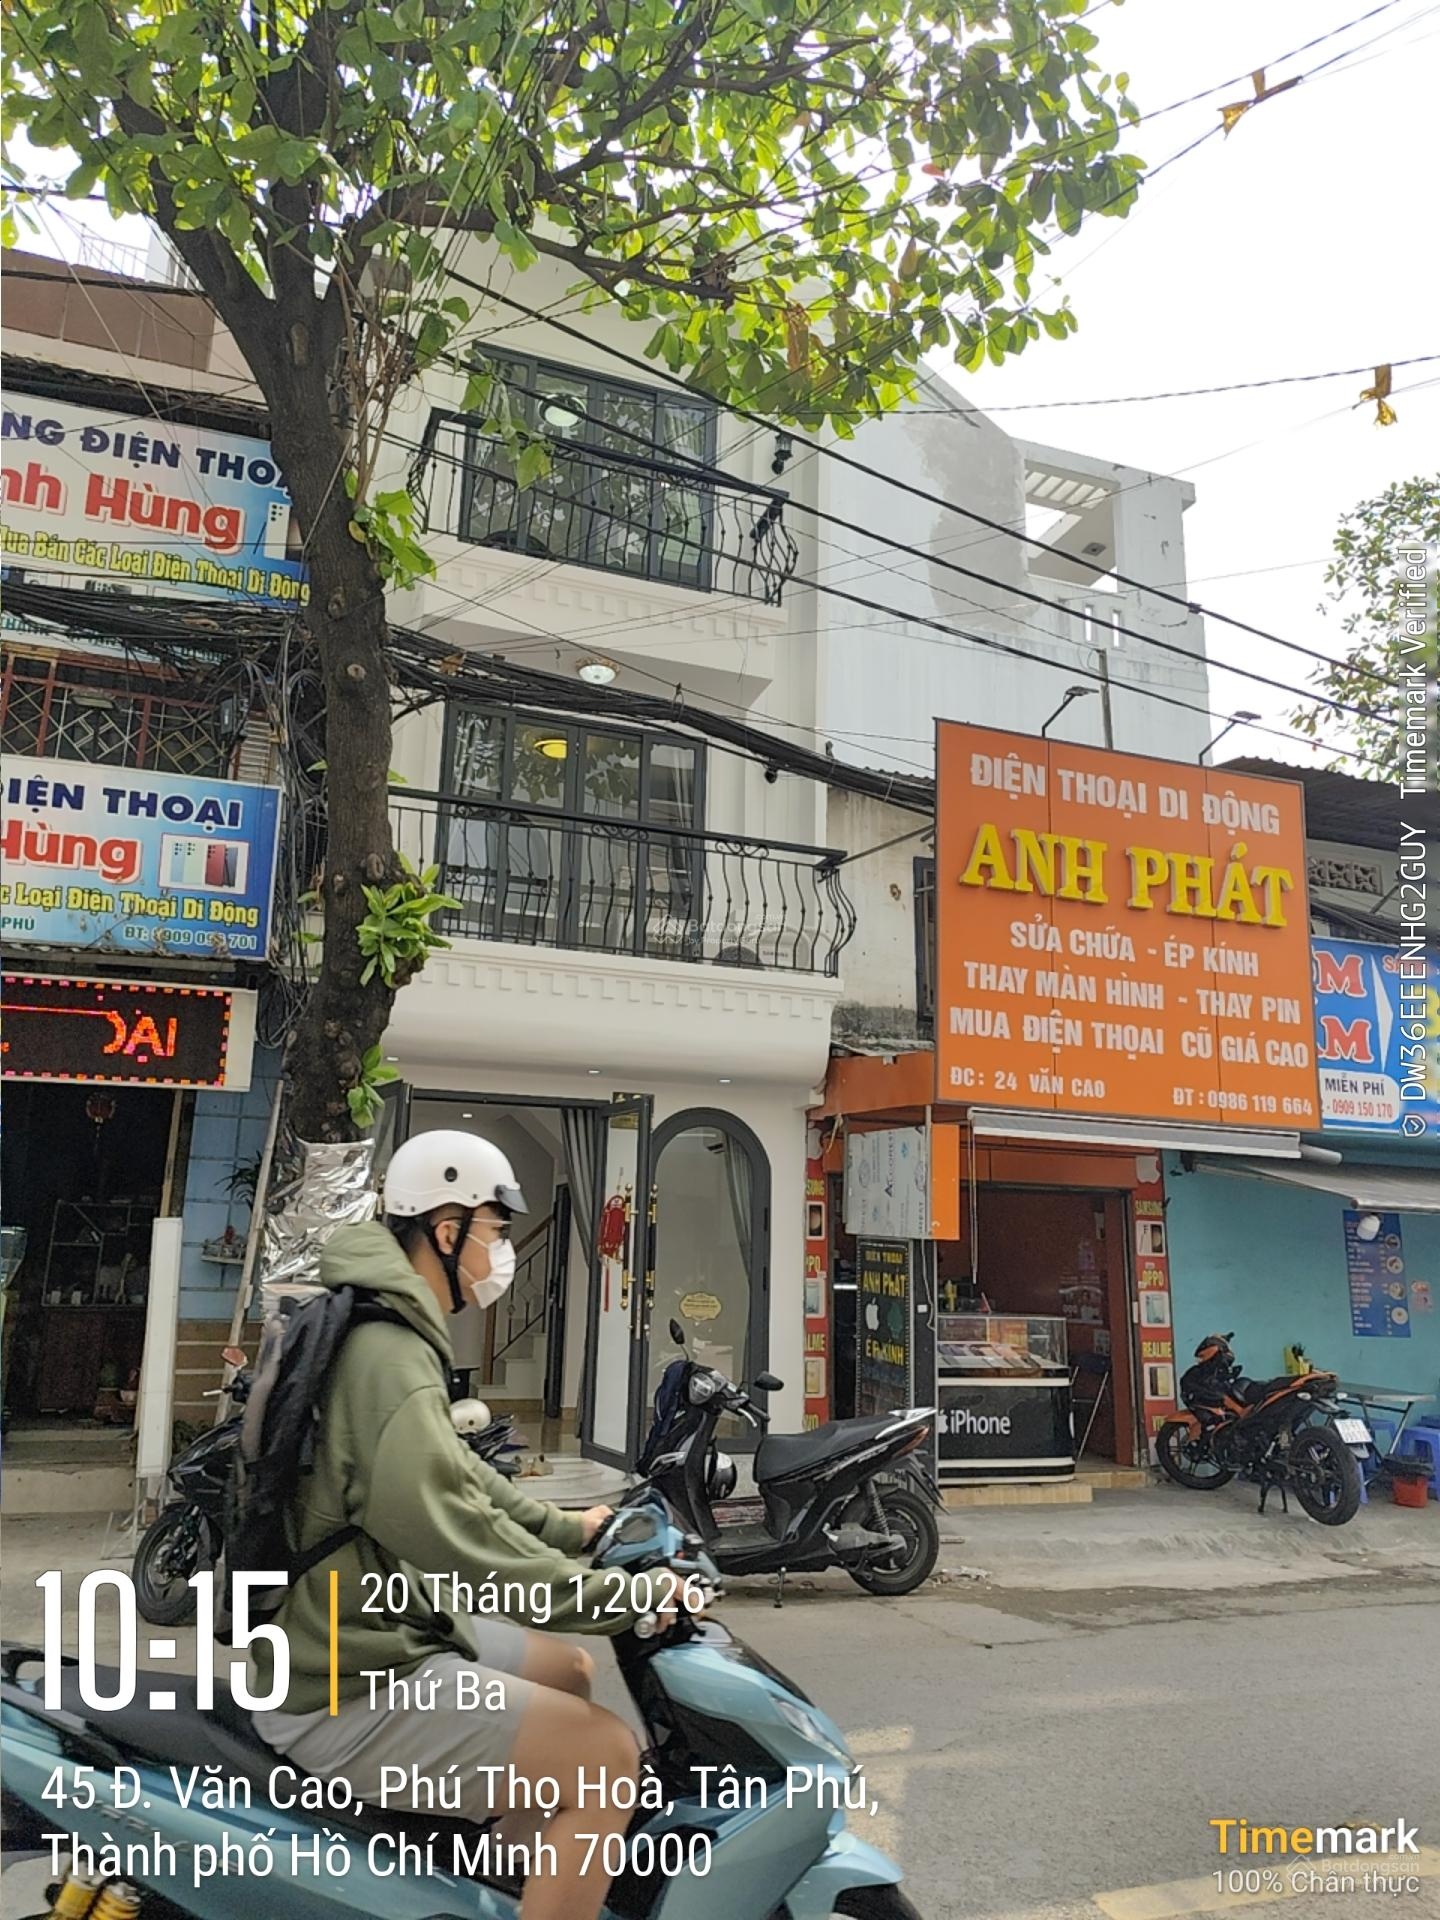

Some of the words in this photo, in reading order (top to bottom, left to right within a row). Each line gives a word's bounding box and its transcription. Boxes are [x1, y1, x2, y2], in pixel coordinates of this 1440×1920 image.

[1, 411, 66, 446] NG
[80, 430, 181, 469] ĐIỆN
[196, 447, 291, 492] THO
[85, 472, 242, 550] Hùng
[33, 531, 70, 562] Bán
[74, 539, 107, 569] Các
[110, 542, 149, 578] Loại
[152, 551, 191, 585] Điện
[195, 559, 243, 595] Thoại
[248, 572, 267, 596] Di
[270, 572, 311, 608] Động
[1, 773, 85, 813] IỆN
[103, 788, 241, 831] THOẠI
[969, 752, 1047, 800] ĐIỆN
[1057, 768, 1148, 818] THOẠI
[1158, 786, 1189, 820] DI
[1201, 790, 1281, 836] ĐỘNG
[15, 882, 63, 912] Loại
[66, 886, 115, 916] Điện
[120, 891, 176, 921] Thoại
[183, 898, 203, 919] Di
[209, 901, 260, 928] Động
[959, 823, 1110, 904] ANH
[1126, 841, 1294, 928] PHÁT
[229, 935, 257, 950] 701
[1010, 913, 1063, 953] SỬA
[1069, 926, 1136, 963] CHỮA
[1164, 934, 1194, 970] ÉP
[1202, 941, 1259, 977] KÍNH
[963, 960, 1029, 995] THAY
[1035, 964, 1097, 1003] MÀN
[1105, 972, 1165, 1011] HÌNH
[1195, 988, 1253, 1021] THAY
[1261, 995, 1302, 1025] PIN
[949, 1006, 1011, 1040] MUA
[1022, 1010, 1083, 1054] ĐIỆN
[1180, 1026, 1213, 1059] CŨ
[1221, 1031, 1259, 1064] GIÁ
[1265, 1039, 1310, 1069] CAO
[994, 1070, 1018, 1091] 24
[1028, 1067, 1064, 1095] VĂN
[1071, 1078, 1106, 1099] CAO
[1207, 1090, 1249, 1111] 0986
[1251, 1094, 1278, 1113] 119
[1282, 1097, 1313, 1116] 664
[1362, 1078, 1385, 1096] PHÍ
[1377, 1103, 1394, 1119] 170
[950, 1409, 1011, 1434] iPhone
